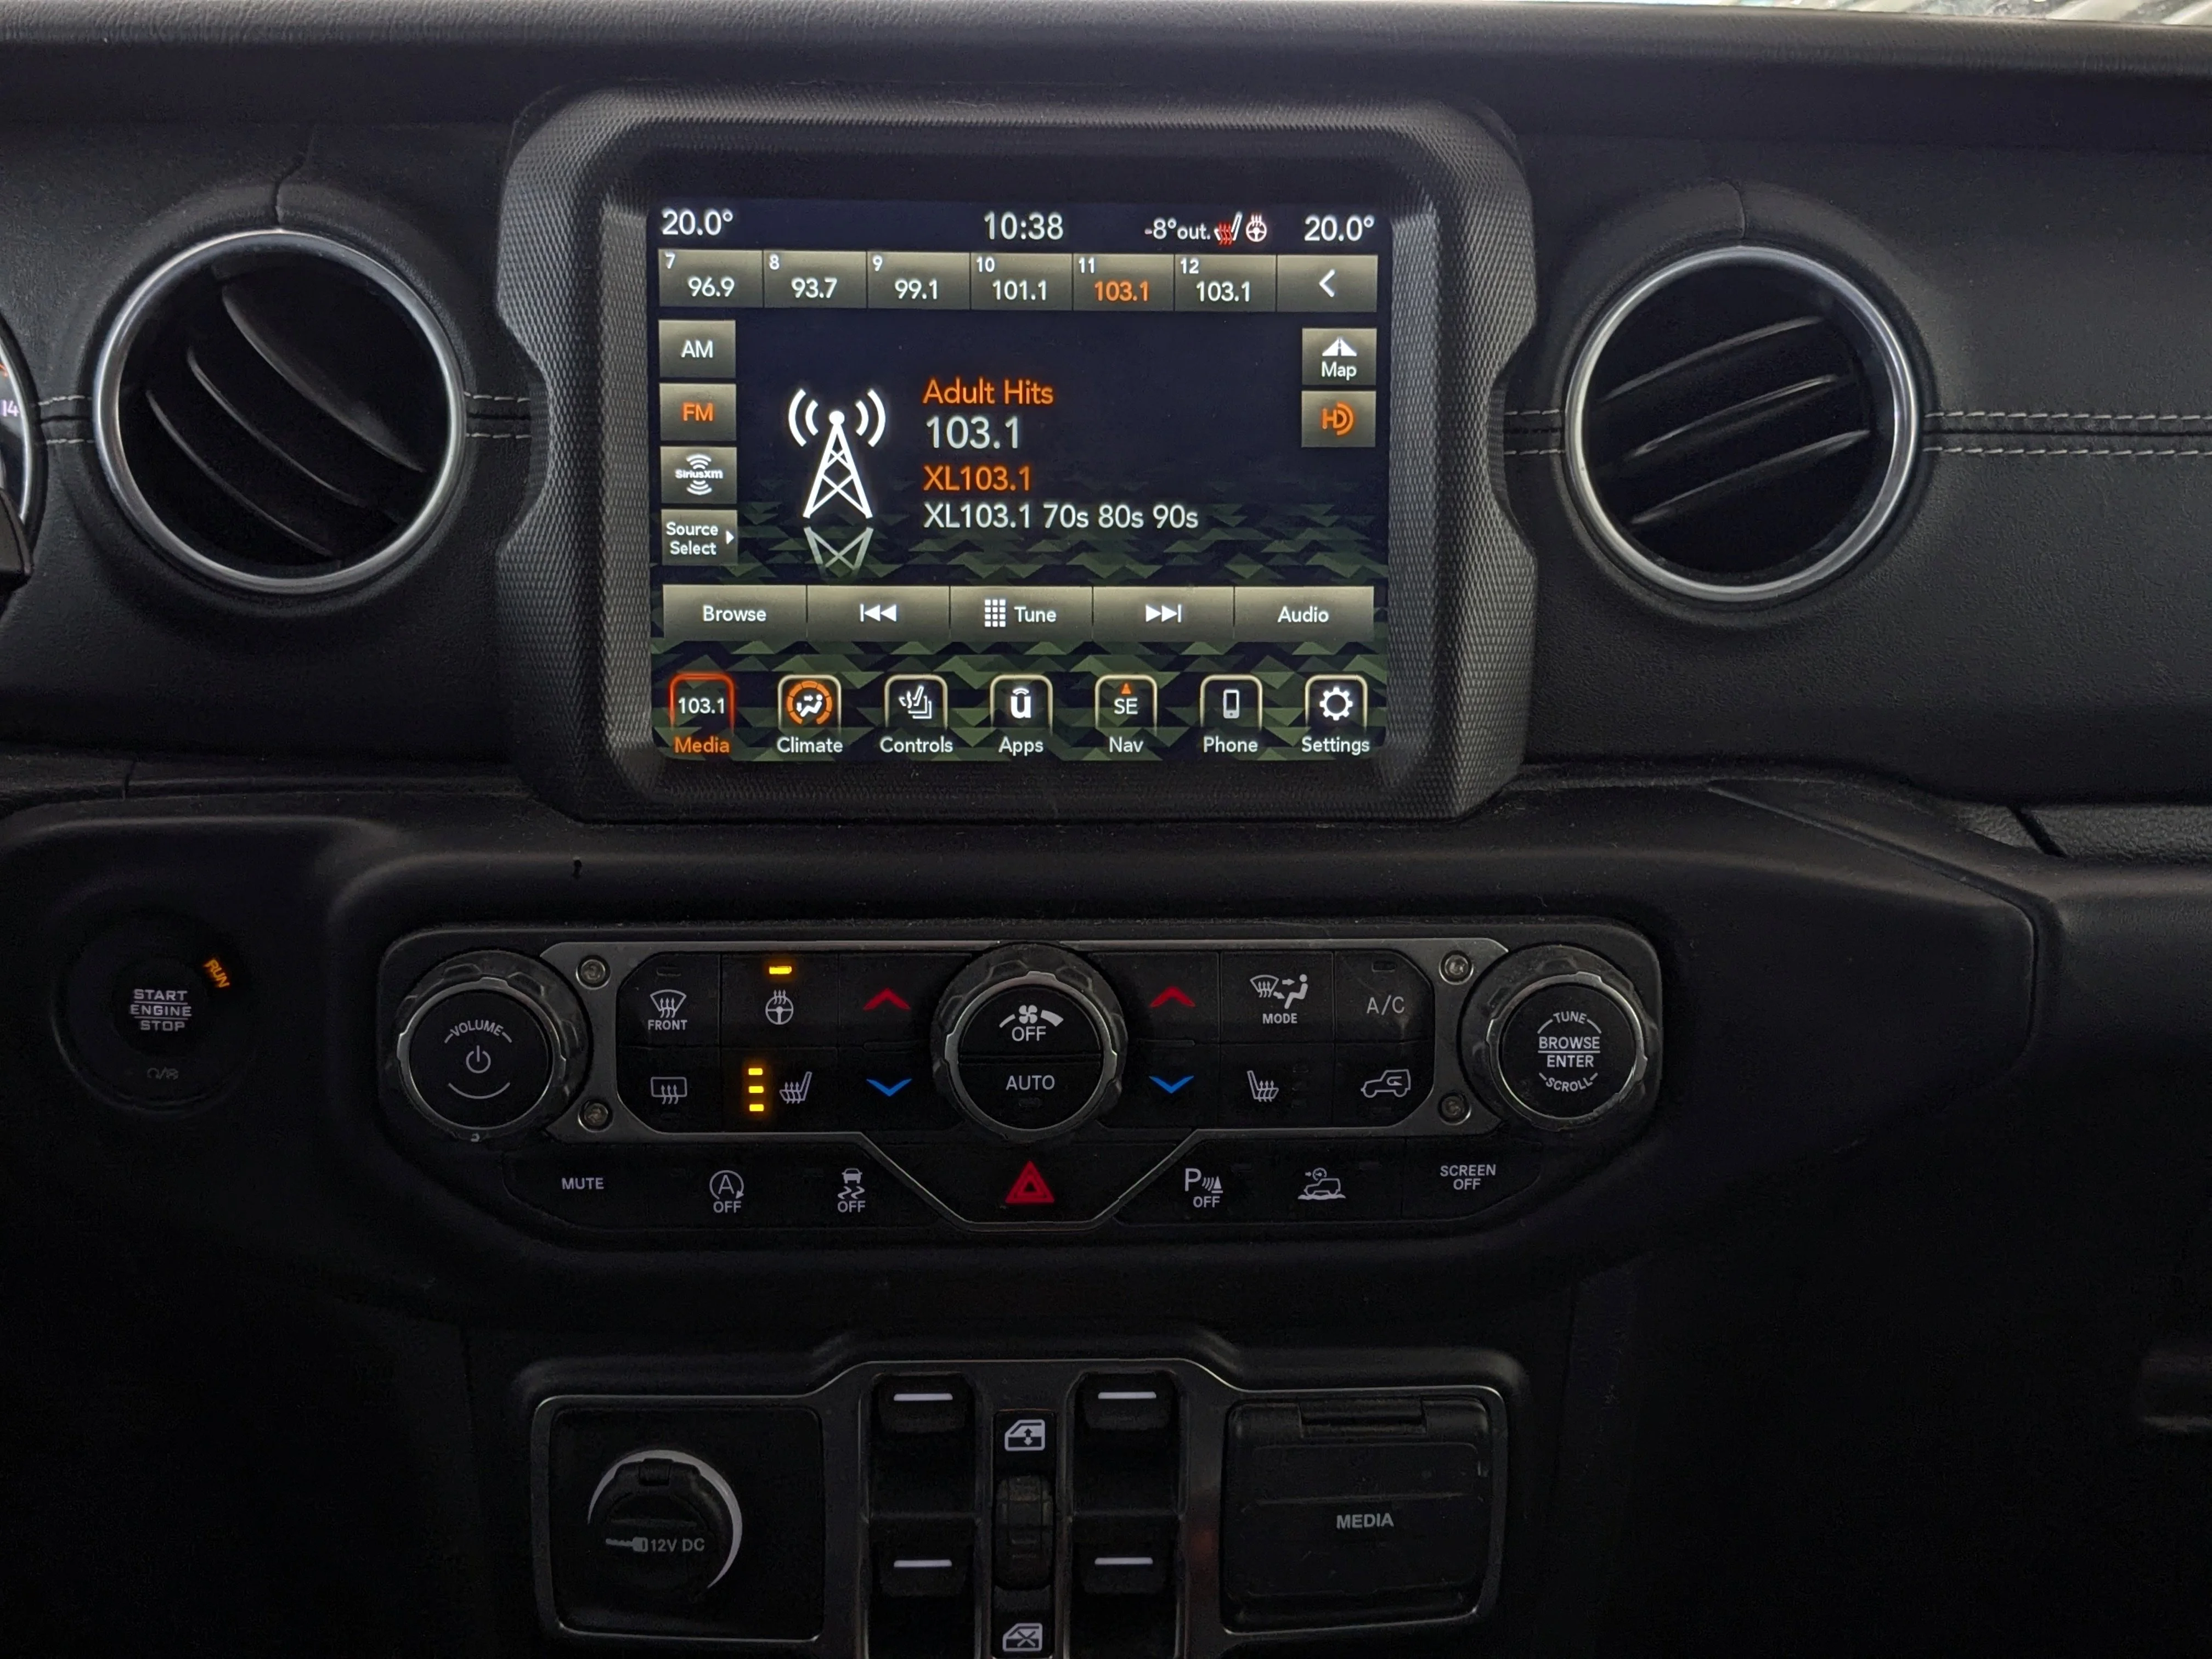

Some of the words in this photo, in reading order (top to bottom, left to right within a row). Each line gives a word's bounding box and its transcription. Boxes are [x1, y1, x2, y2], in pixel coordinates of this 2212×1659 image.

[984, 211, 1064, 240] 10:38
[665, 253, 675, 269] 7
[769, 254, 780, 270] 8
[873, 255, 883, 271] 9
[976, 257, 995, 272] 10
[1078, 258, 1095, 273] 11
[1180, 258, 1199, 274] 12
[688, 277, 735, 297] 96.9
[791, 278, 837, 298] 93.7
[895, 279, 939, 300] 99.1
[992, 280, 1047, 301] 101.1
[1094, 281, 1149, 302] 103.1
[1196, 281, 1251, 302] 103.1
[681, 340, 714, 358] AM
[1321, 363, 1357, 381] Map
[922, 377, 995, 405] Adult
[1004, 380, 1054, 405] Hits
[682, 403, 714, 422] FM
[926, 416, 1020, 449] 103.1
[923, 465, 1031, 492] XL103.1
[924, 503, 1031, 529] XL103.1
[1042, 503, 1090, 529] 70s
[1098, 504, 1144, 529] 80s
[1153, 504, 1199, 529] 90s
[666, 522, 719, 537] Source
[669, 541, 717, 556] Select
[702, 605, 767, 622] Browse
[1014, 606, 1057, 623] Tune
[1277, 606, 1330, 624] Audio
[678, 697, 725, 714] 103.1
[1113, 698, 1138, 715] SE
[674, 737, 730, 754] Media
[776, 736, 843, 754] Climate
[879, 736, 953, 753] Controls
[998, 737, 1044, 758] Apps
[1109, 737, 1144, 753] Nav
[1203, 737, 1259, 753] Phone
[1301, 737, 1371, 758] Settings
[202, 958, 230, 989] RUN
[133, 989, 188, 1001] START
[129, 1004, 192, 1017] ENGINE
[1366, 996, 1406, 1015] A/C
[139, 1020, 185, 1032] STOP
[647, 1019, 688, 1031] FRONT
[1262, 1013, 1298, 1024] MODE
[1553, 1011, 1588, 1025] TUNE
[450, 1019, 504, 1036] VOLUME
[1011, 1026, 1046, 1042] OFF
[1538, 1036, 1600, 1049] BROWSE
[1547, 1055, 1594, 1068] ENTER
[1006, 1075, 1055, 1091] AUTO
[1545, 1076, 1594, 1092] SCROLL
[1440, 1164, 1496, 1177] SCREEN
[561, 1177, 604, 1190] MUTE
[1184, 1168, 1201, 1191] P
[1453, 1178, 1481, 1190] OFF
[713, 1201, 742, 1214] OFF
[837, 1200, 865, 1213] OFF
[1193, 1196, 1220, 1207] OFF
[1336, 1513, 1394, 1529] MEDIA
[650, 1538, 678, 1551] 12V
[682, 1538, 705, 1552] DC
